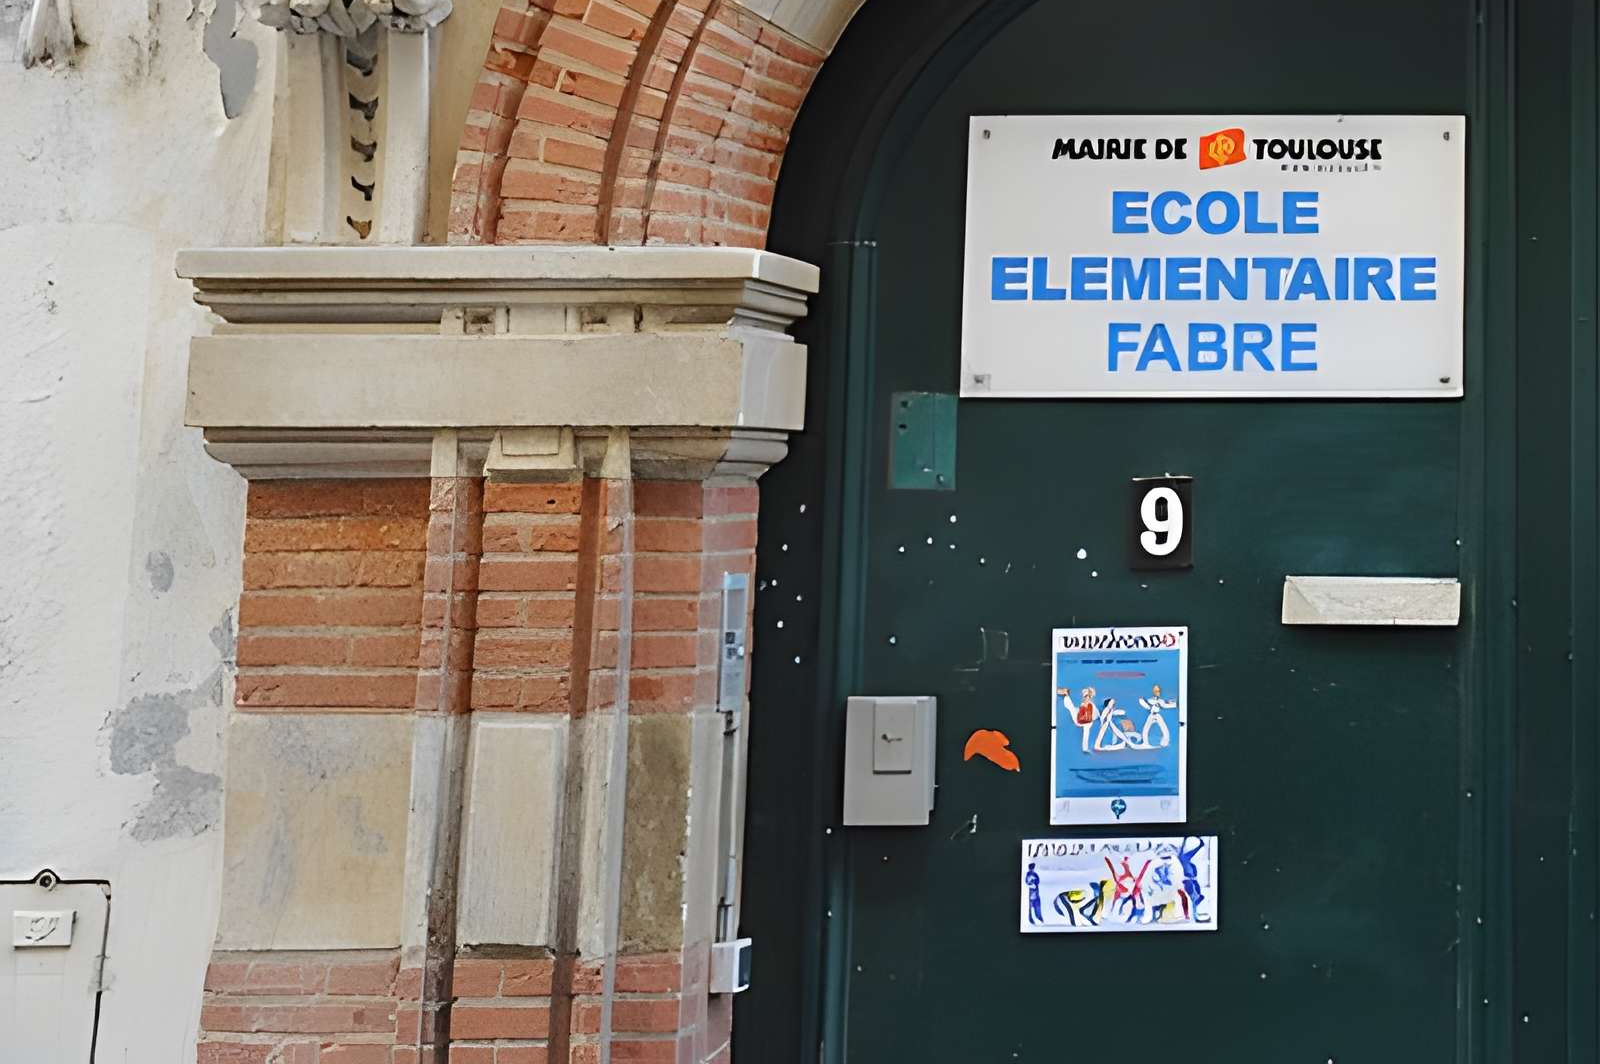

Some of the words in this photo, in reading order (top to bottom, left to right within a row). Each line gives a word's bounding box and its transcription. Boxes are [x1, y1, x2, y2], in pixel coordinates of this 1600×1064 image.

[1051, 138, 1147, 160] MAIRIE
[1154, 138, 1188, 160] DE
[1252, 138, 1383, 161] TOULOUSE
[1110, 189, 1321, 236] ECOLE
[990, 255, 1438, 303] ELEMENTAIRE
[1106, 321, 1320, 374] FABRE
[1140, 486, 1184, 556] 9
